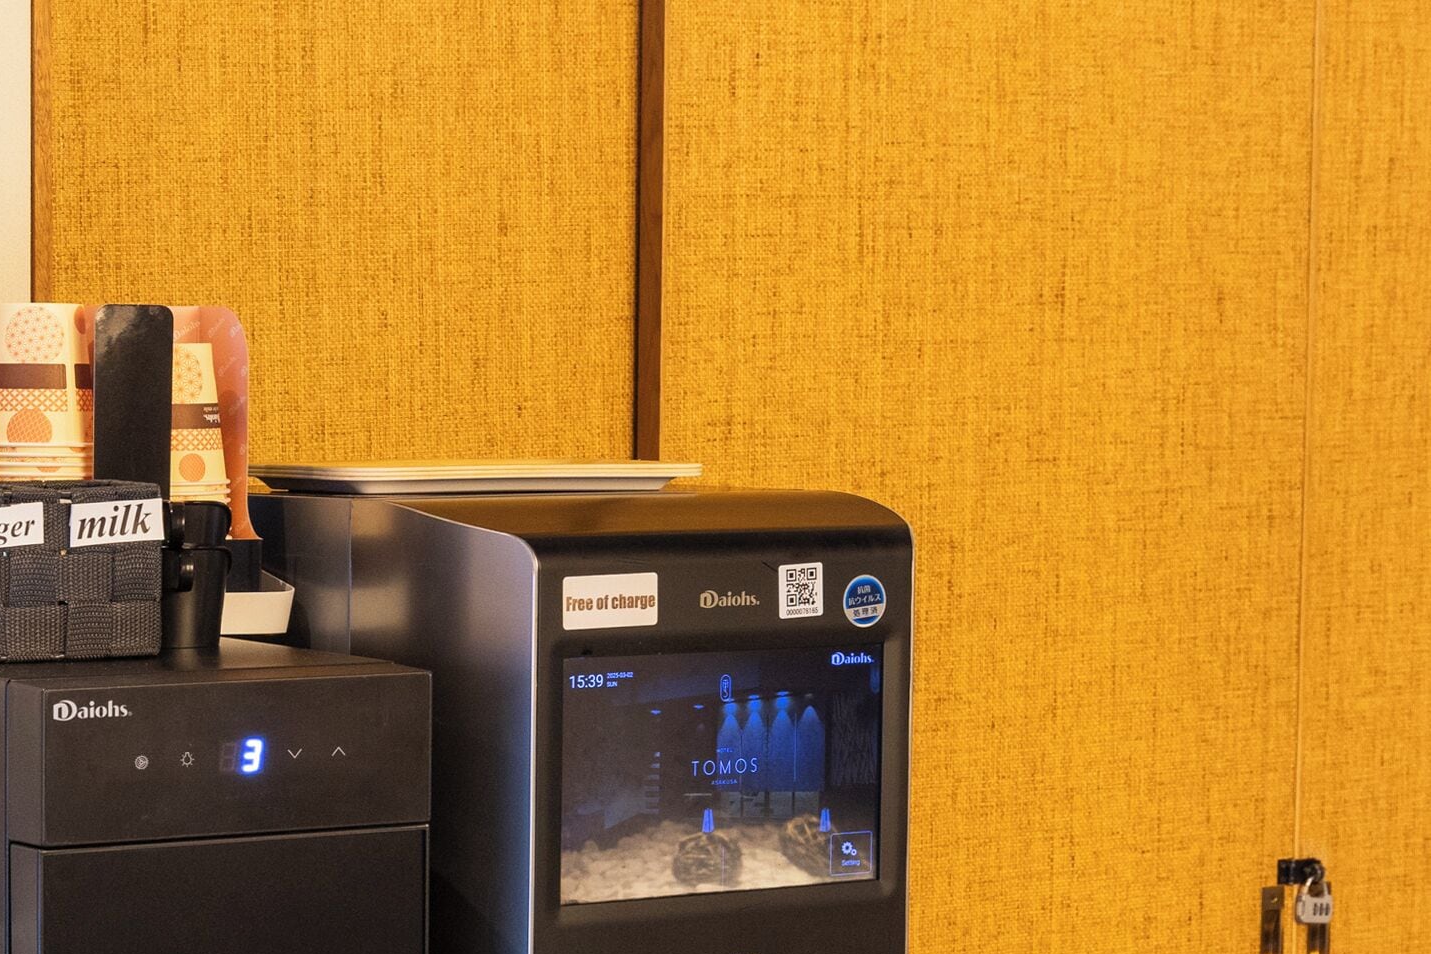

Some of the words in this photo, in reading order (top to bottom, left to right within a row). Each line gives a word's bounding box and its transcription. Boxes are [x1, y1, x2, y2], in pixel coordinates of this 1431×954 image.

[77, 503, 153, 540] milk
[565, 596, 593, 612] Free
[596, 594, 609, 610] of
[611, 594, 655, 610] charge
[849, 594, 882, 606] 抗ウイルス
[569, 674, 604, 688] 15:39
[240, 738, 265, 774] 3
[691, 758, 757, 776] TOMOS
